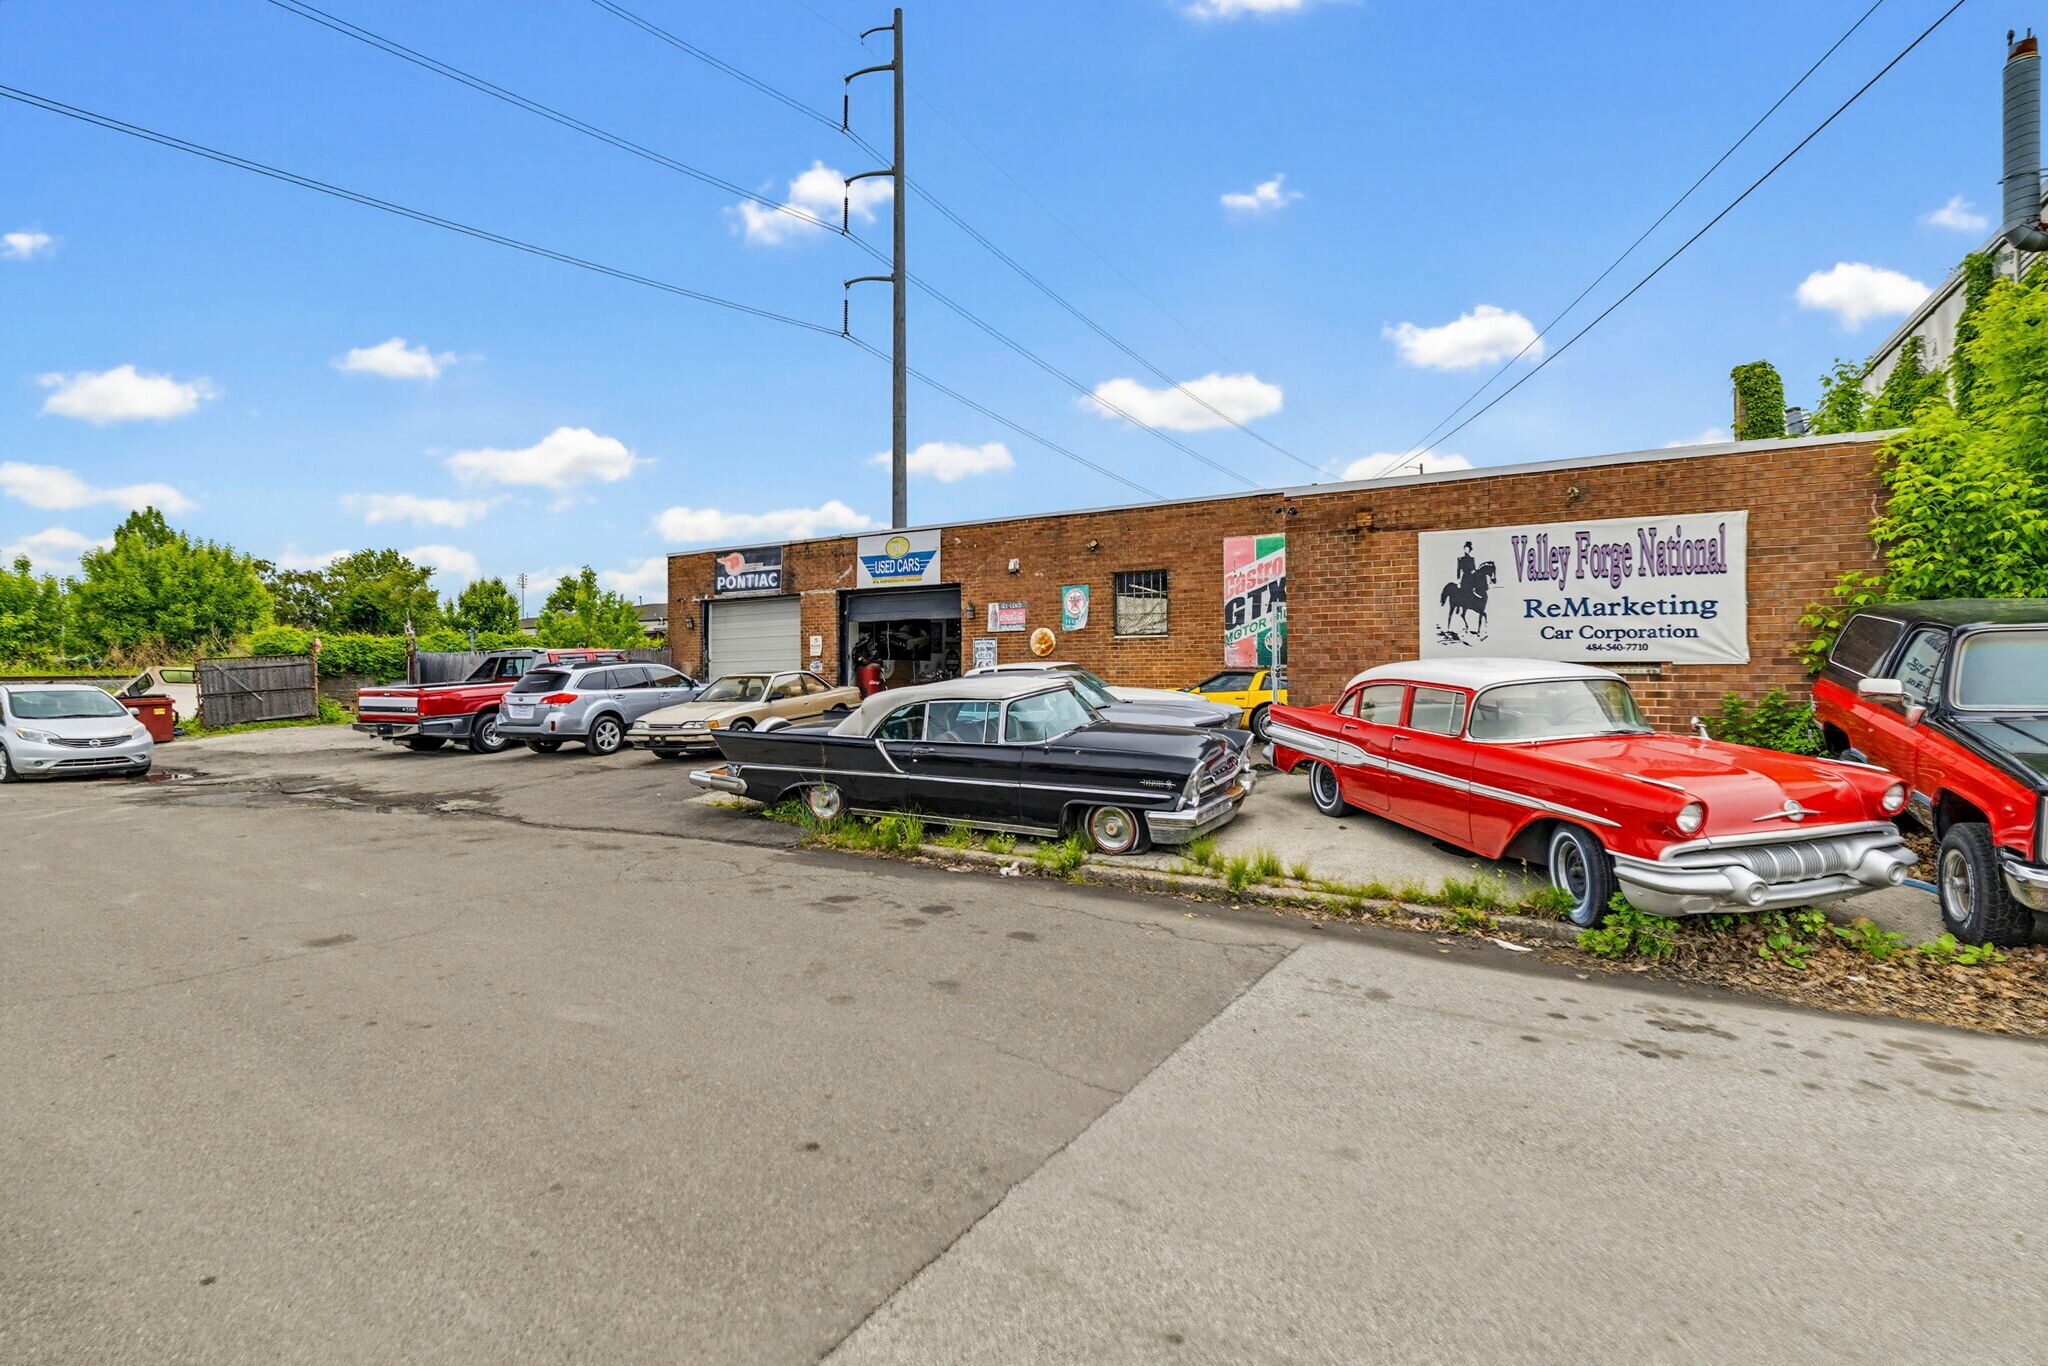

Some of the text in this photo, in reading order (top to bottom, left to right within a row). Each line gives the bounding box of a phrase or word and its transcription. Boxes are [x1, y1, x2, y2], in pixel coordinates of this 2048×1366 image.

[874, 557, 920, 574] USED CARS
[1511, 522, 1727, 591] Valley Forge National
[717, 572, 778, 590] PONTIAC
[1224, 577, 1287, 632] GTX
[1523, 594, 1719, 619] ReMarketing
[1225, 617, 1267, 644] MOTOR
[1540, 624, 1699, 641] Car Corporation
[1586, 643, 1649, 651] 484-540-7710
